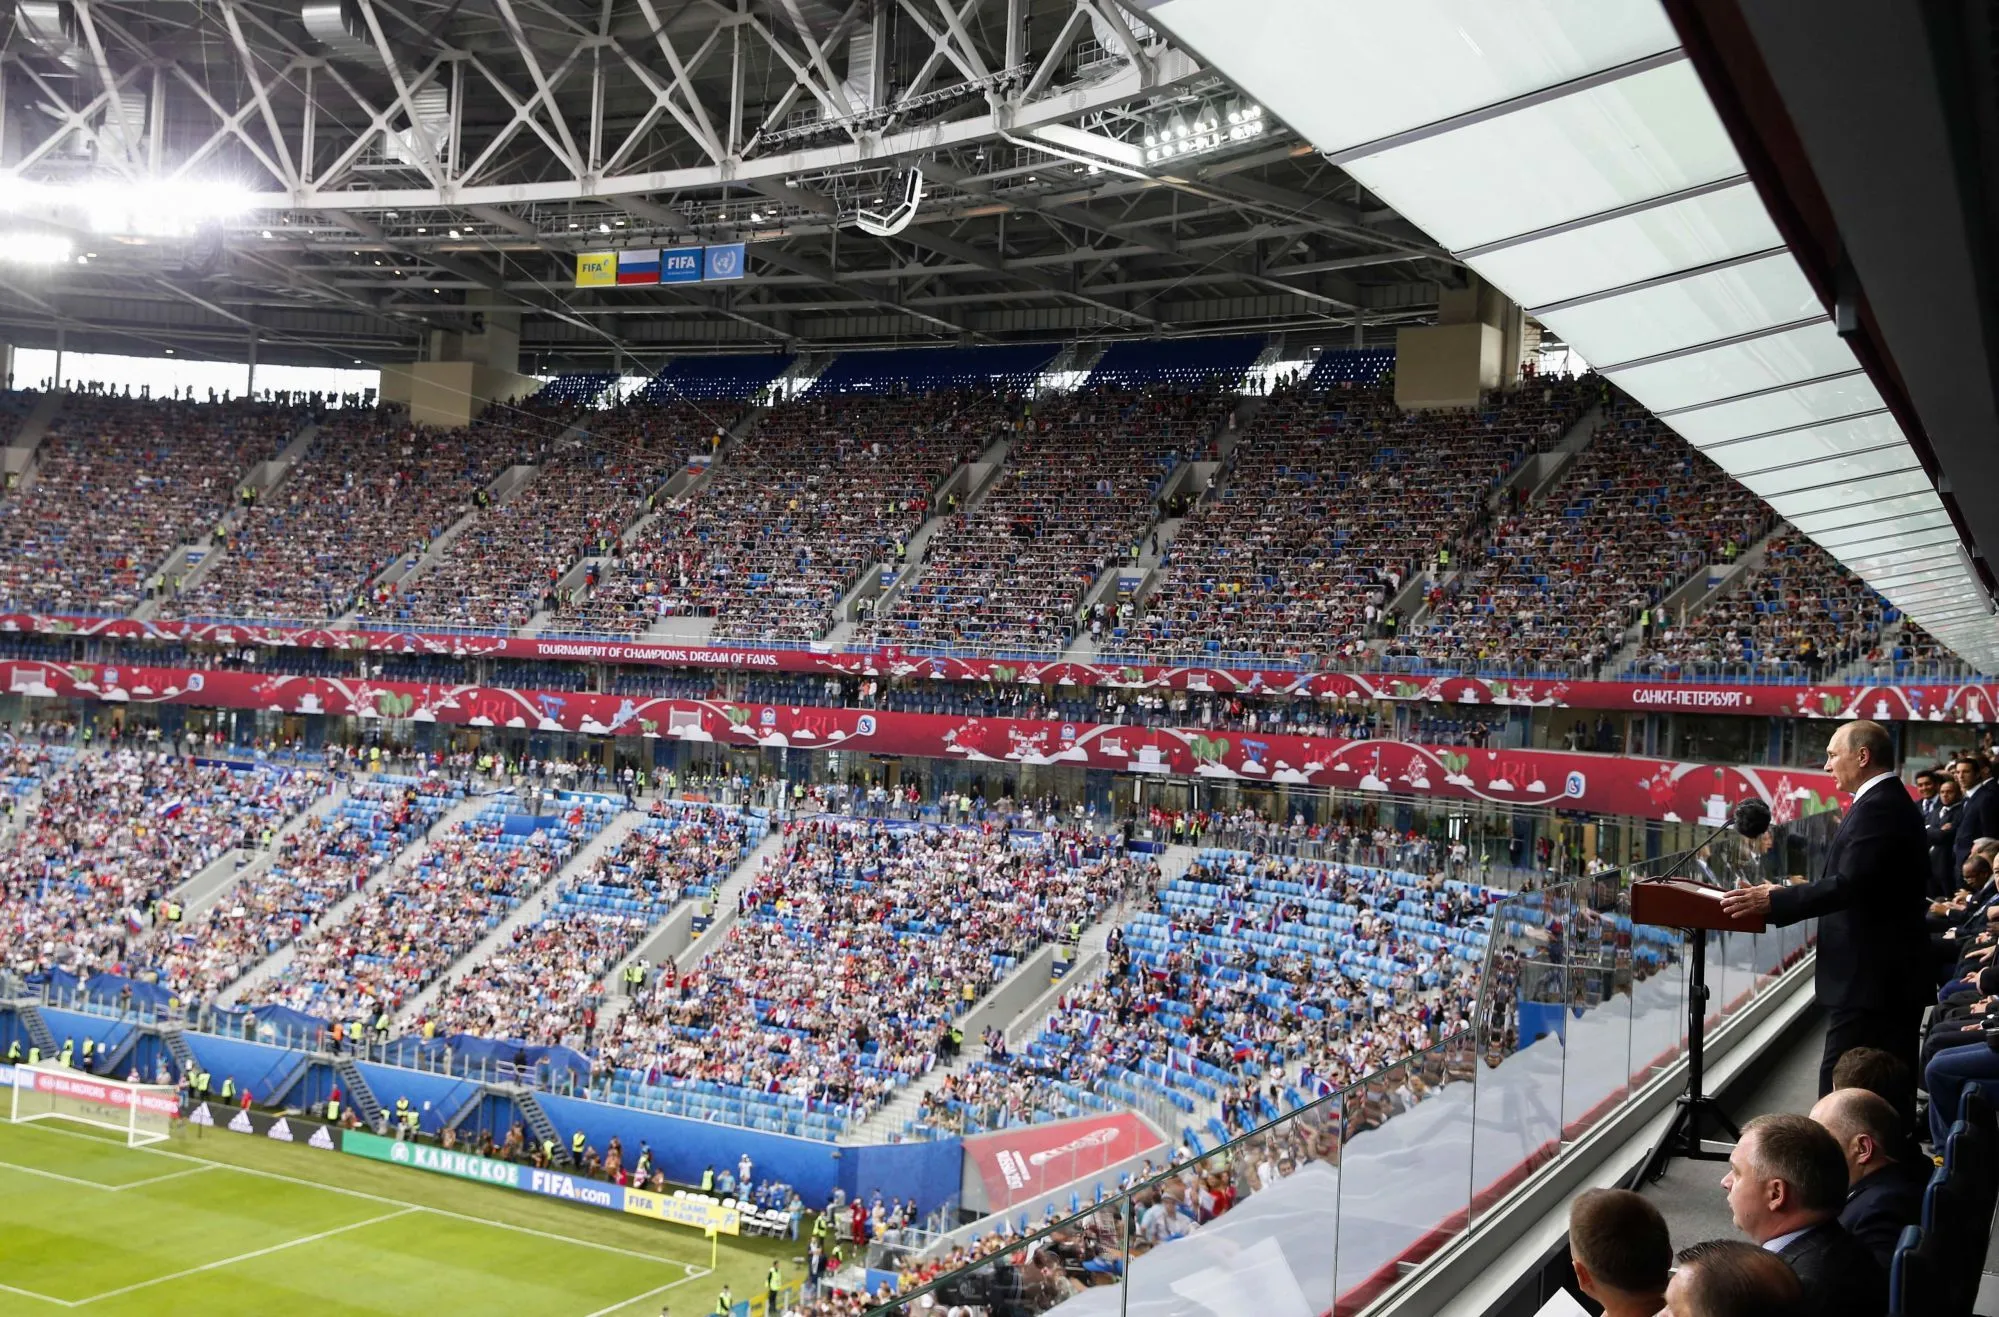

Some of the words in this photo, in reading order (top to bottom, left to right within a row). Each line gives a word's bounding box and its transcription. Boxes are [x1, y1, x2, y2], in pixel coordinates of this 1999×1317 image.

[582, 263, 602, 273] FIFA
[667, 256, 695, 270] FIFA
[537, 643, 607, 657] TOURNAMENT
[608, 646, 622, 658] OF
[689, 650, 729, 663] DREAM
[730, 652, 745, 665] OF
[746, 653, 778, 666] FANS.
[1632, 688, 1743, 707] САНКТ-ПЕТЕРБУРГ
[532, 1170, 610, 1206] FIFA.com
[629, 1195, 653, 1210] FIFA
